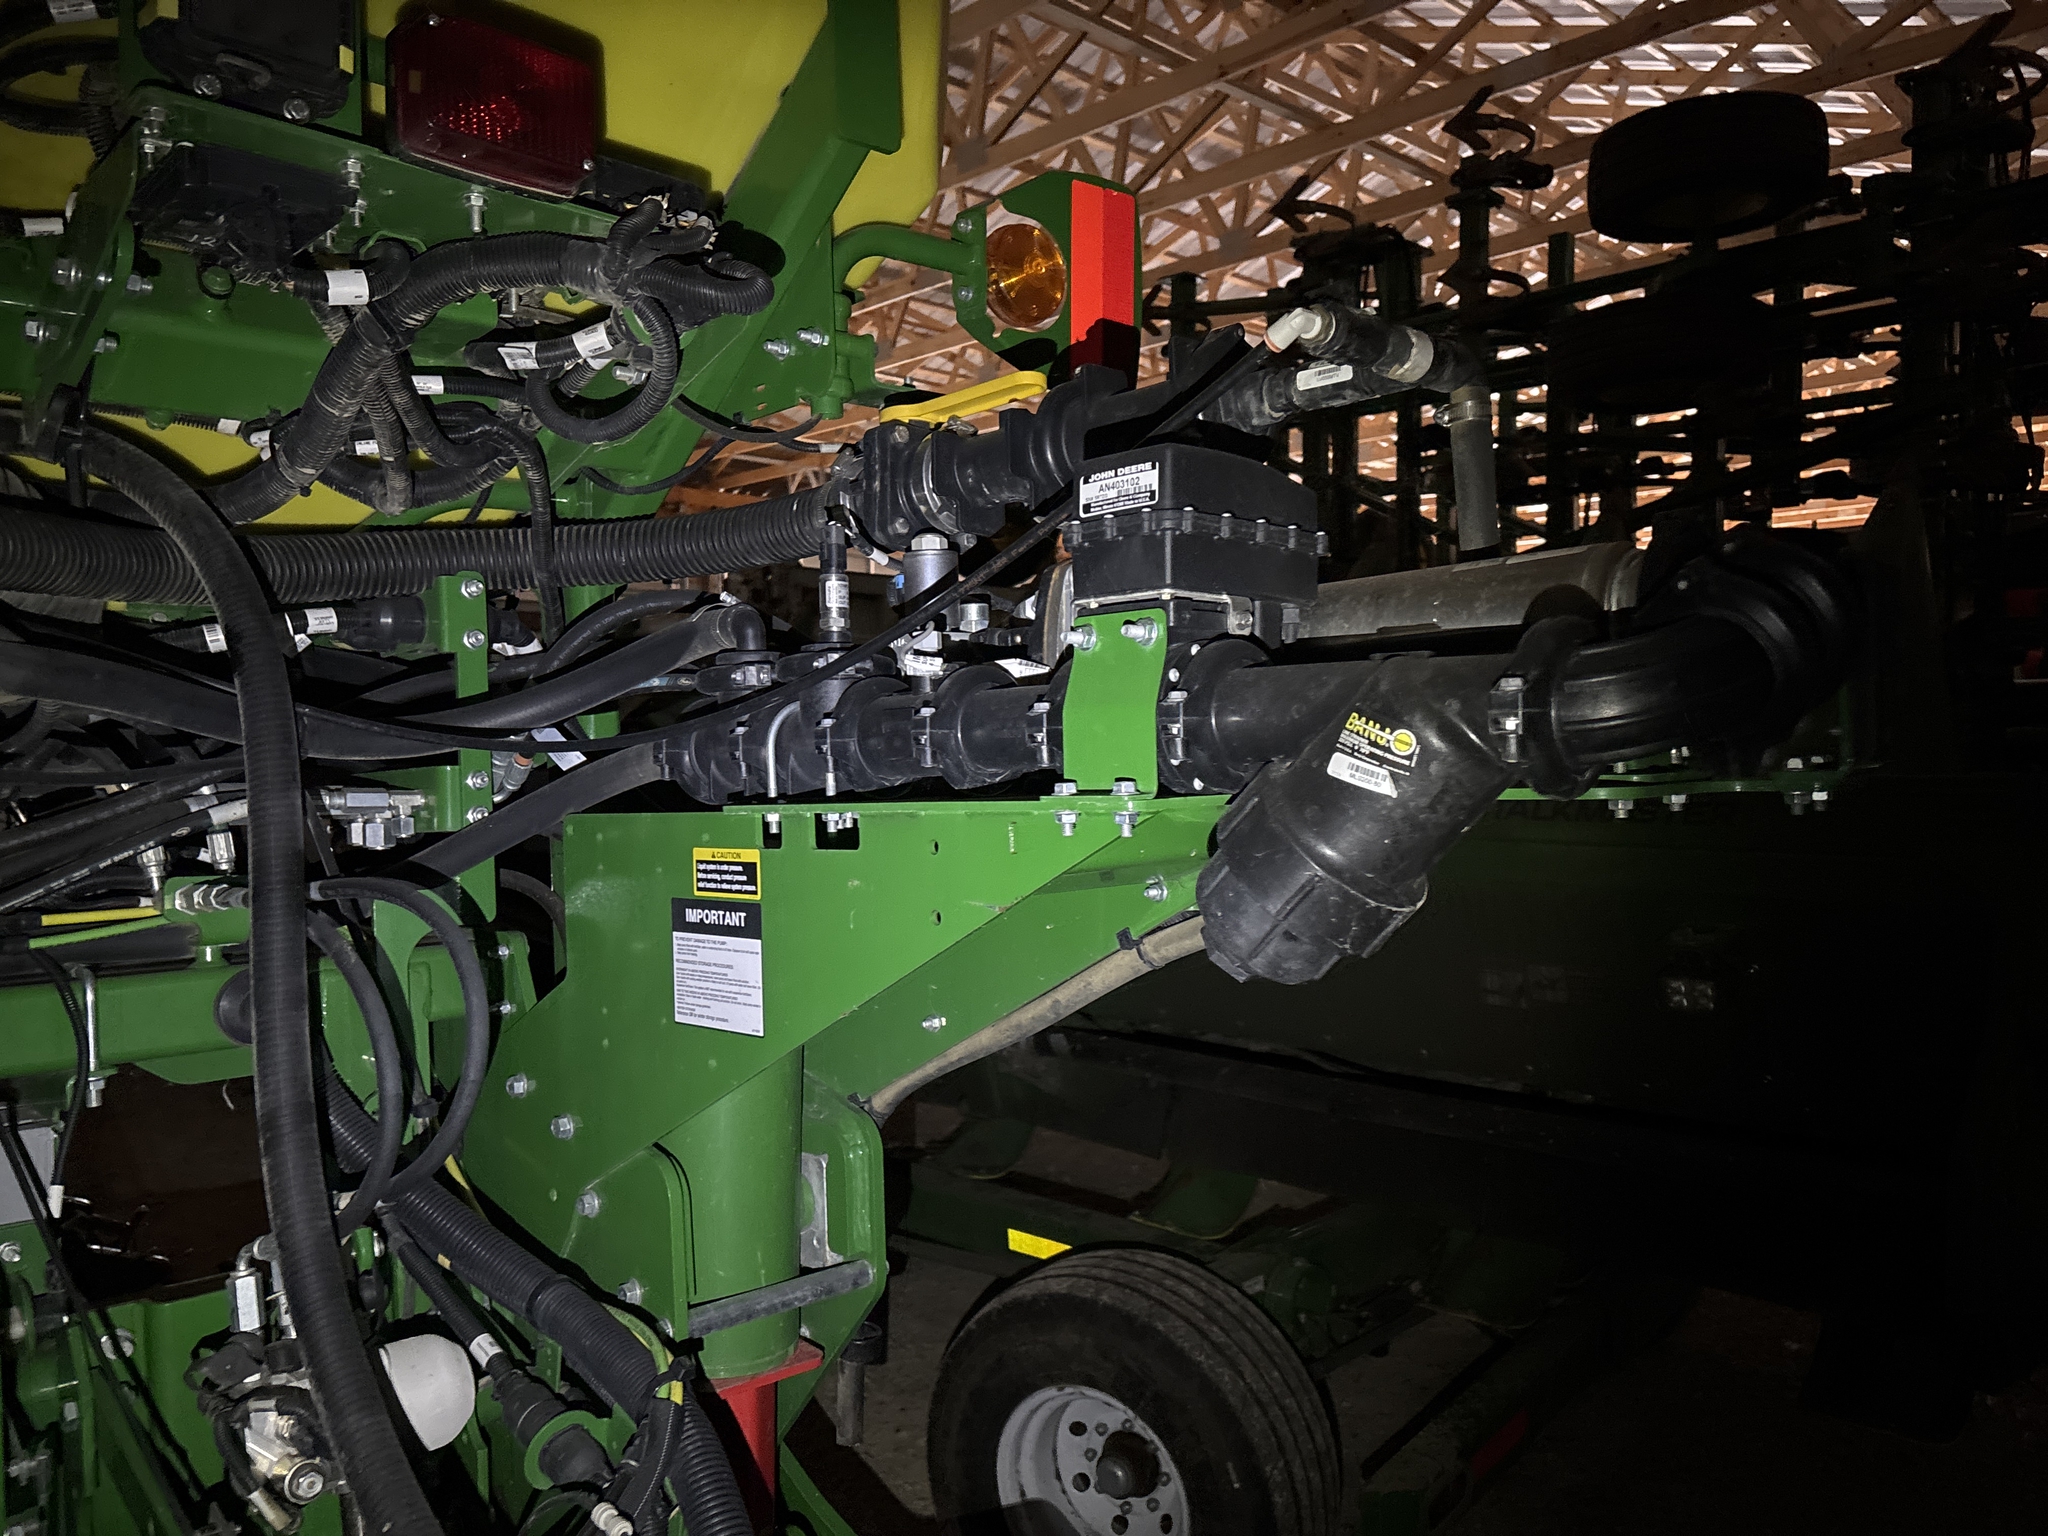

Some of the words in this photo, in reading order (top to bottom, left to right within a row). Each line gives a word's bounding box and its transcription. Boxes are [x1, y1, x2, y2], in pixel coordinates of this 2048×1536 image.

[1088, 470, 1115, 482] JOHN
[1117, 462, 1152, 475] DEERE
[1098, 476, 1140, 493] AN403102
[716, 851, 742, 860] CAUTION
[685, 908, 747, 927] IMPORTANT
